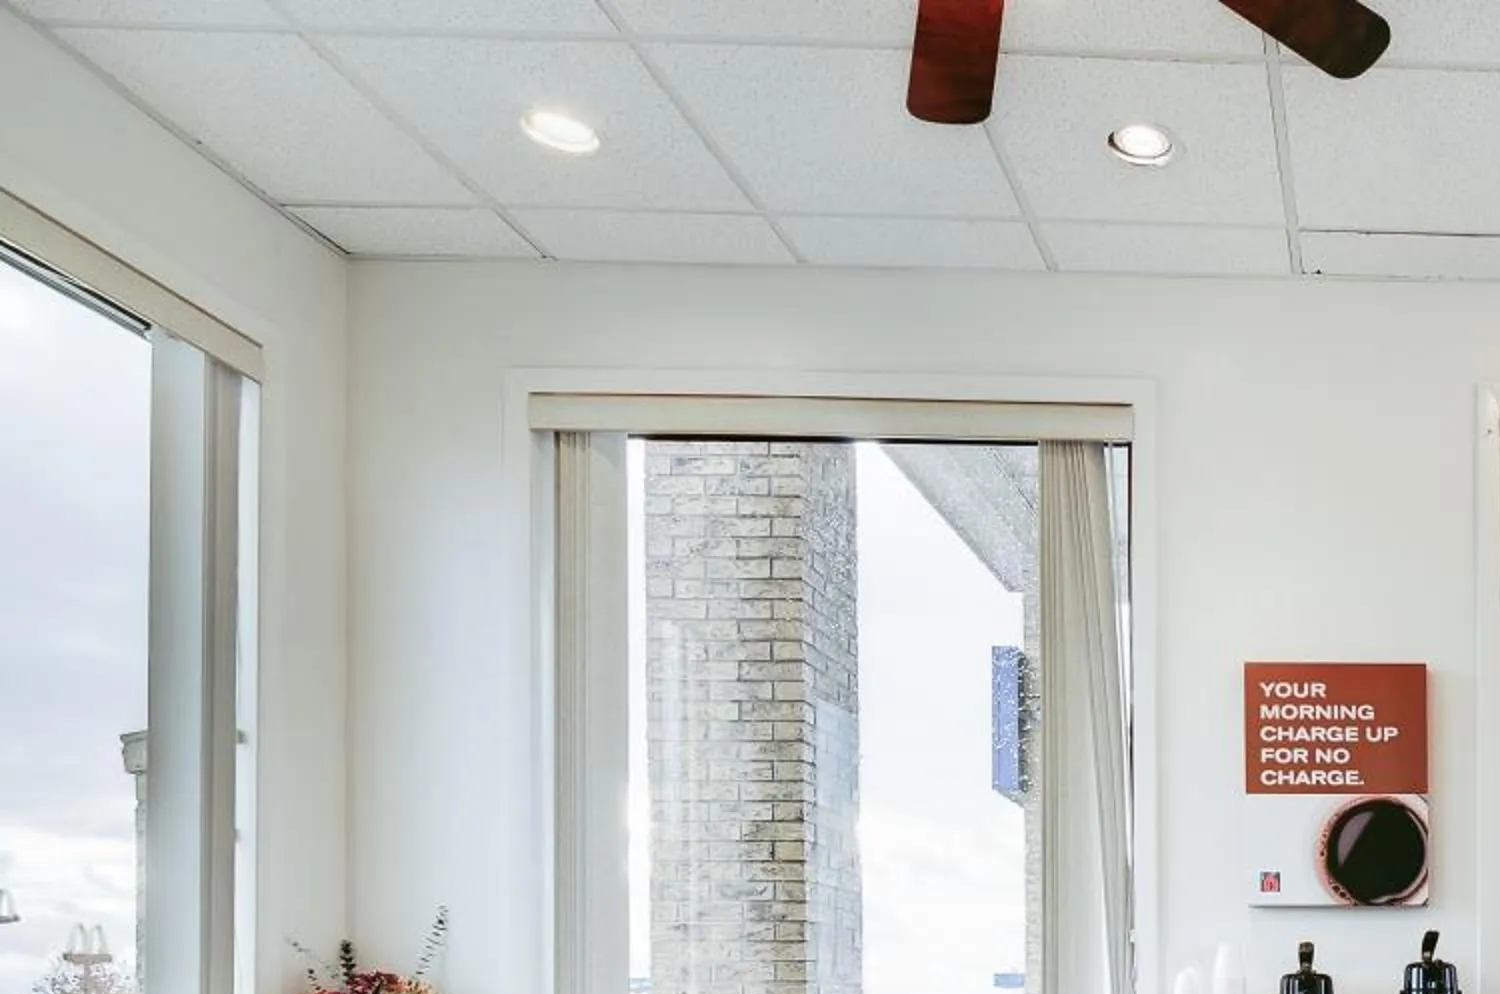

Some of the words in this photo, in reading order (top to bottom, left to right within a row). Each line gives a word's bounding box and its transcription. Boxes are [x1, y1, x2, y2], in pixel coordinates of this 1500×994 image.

[1260, 682, 1327, 698] YOUR
[1260, 704, 1375, 720] MORNING
[1260, 726, 1359, 742] CHARGE
[1366, 726, 1399, 742] UP
[1260, 748, 1309, 763] FOR
[1315, 748, 1351, 763] NO
[1260, 770, 1365, 785] CHARGE.
